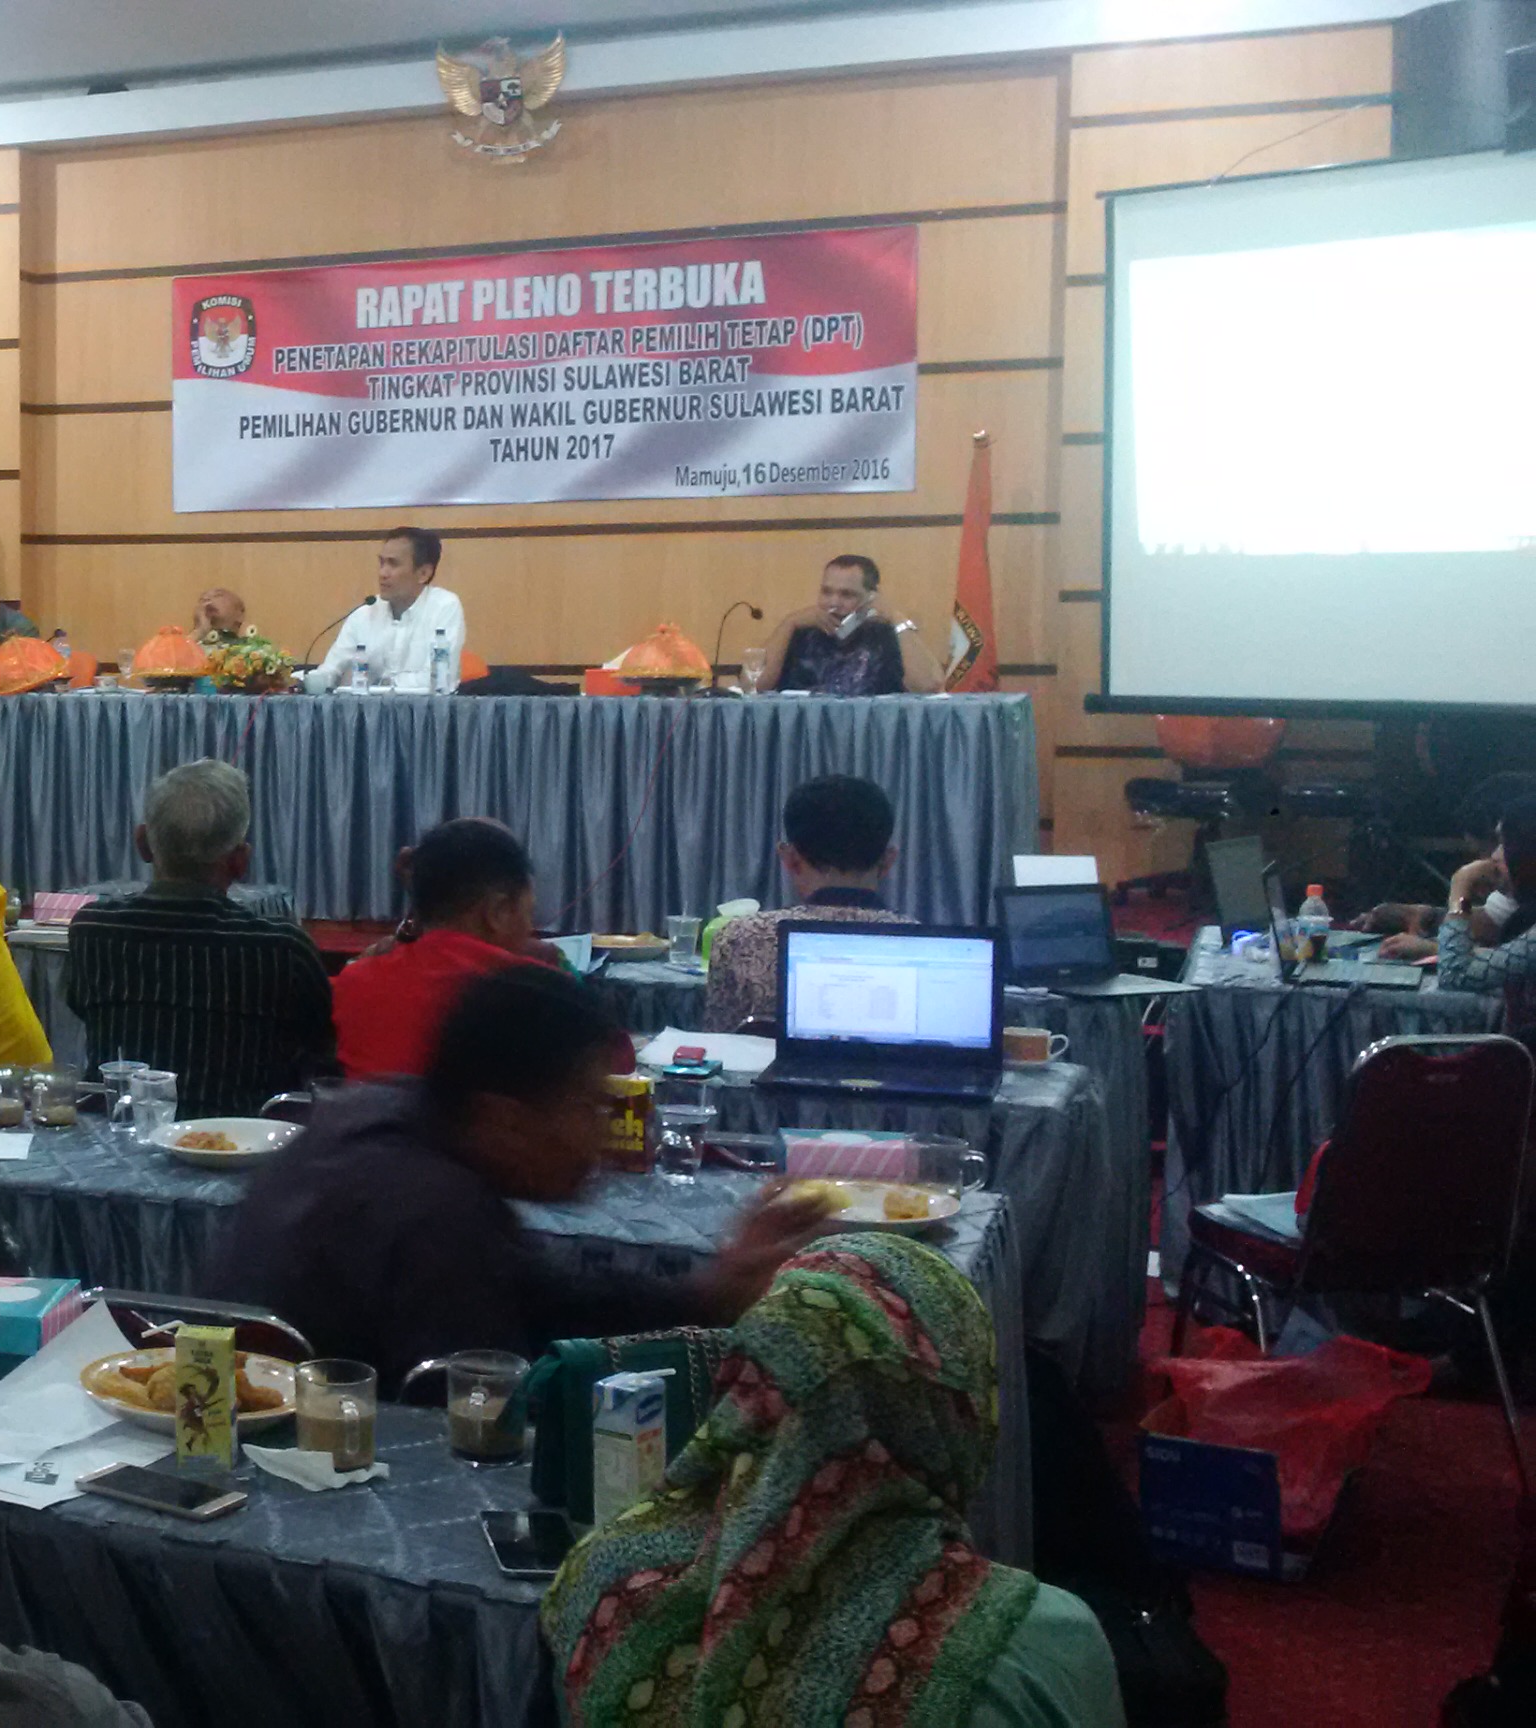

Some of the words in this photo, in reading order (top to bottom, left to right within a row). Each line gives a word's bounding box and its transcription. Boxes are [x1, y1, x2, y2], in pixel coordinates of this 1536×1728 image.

[202, 296, 242, 310] KOMISI
[356, 280, 465, 329] RAPAT
[472, 273, 582, 321] PLENO
[590, 260, 766, 314] TERBUKA
[273, 342, 386, 373] PENETAPAN
[392, 333, 537, 366] REKAPITULASI
[545, 329, 625, 358] DAFTAR
[632, 324, 720, 353] PEMILIH
[727, 319, 796, 348] TETAP
[803, 313, 863, 351] (DPT)
[368, 373, 456, 401] TINGKAT
[462, 367, 556, 396] PROVINSI
[564, 361, 670, 391] SULAWESI
[679, 357, 751, 386] BARAT
[239, 412, 341, 440] PEMILIHAN
[348, 406, 457, 435] GUBERNUR
[464, 404, 504, 430] DAN
[511, 401, 576, 428] WAKIL
[583, 395, 702, 425] GUBERNUR
[709, 389, 822, 419] SULAWESI
[831, 386, 905, 414] BARAT
[490, 436, 559, 463] TAHUN
[567, 434, 615, 460] 2017
[770, 461, 846, 483] Desember
[852, 457, 890, 481] 2016
